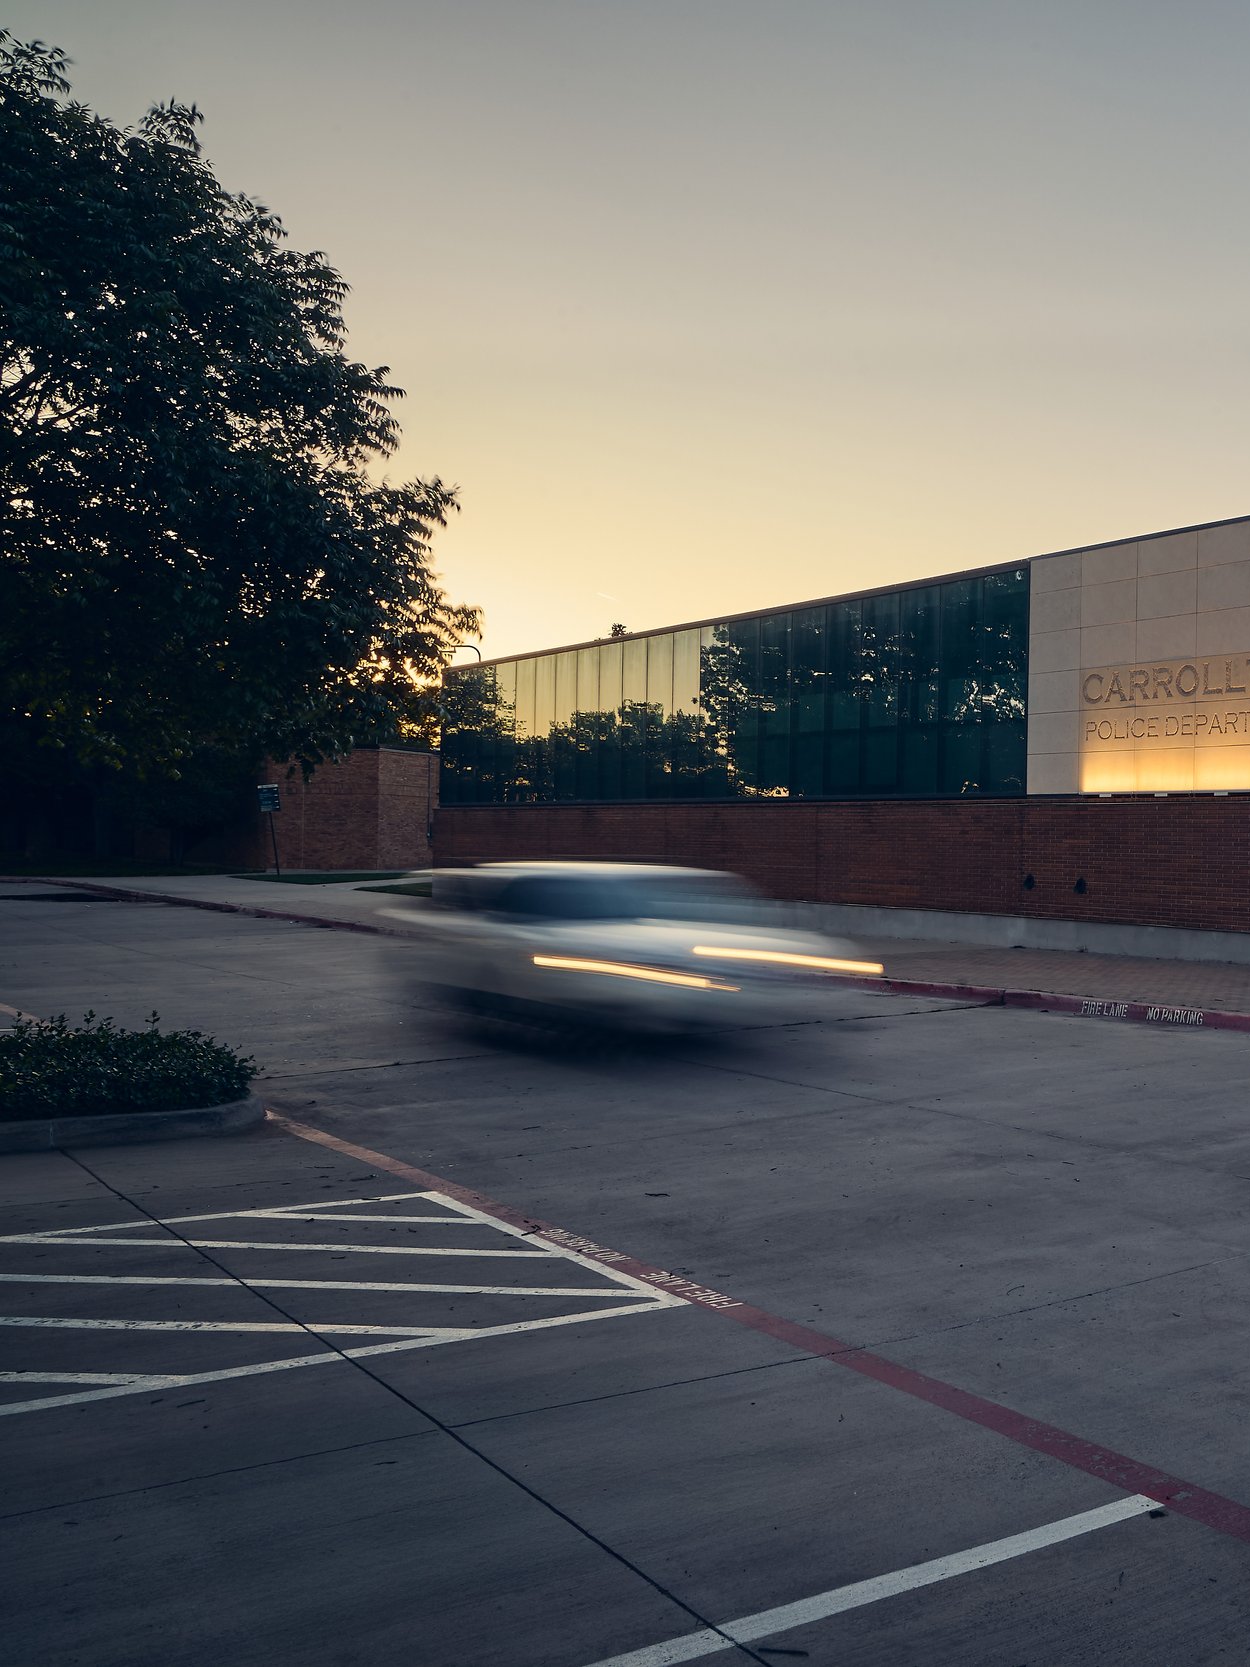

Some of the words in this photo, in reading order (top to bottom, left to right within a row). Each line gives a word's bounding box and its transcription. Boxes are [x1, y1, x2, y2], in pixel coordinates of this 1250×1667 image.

[1085, 716, 1159, 741] POLICE
[1081, 1000, 1102, 1015] FIRE
[1103, 1003, 1128, 1018] LANE
[1146, 1007, 1159, 1021] NO
[1161, 1009, 1203, 1025] PARKING
[540, 1228, 611, 1254] PARKING
[594, 1251, 632, 1263] NO
[640, 1271, 702, 1293] LANE
[689, 1289, 744, 1309] FIRE
